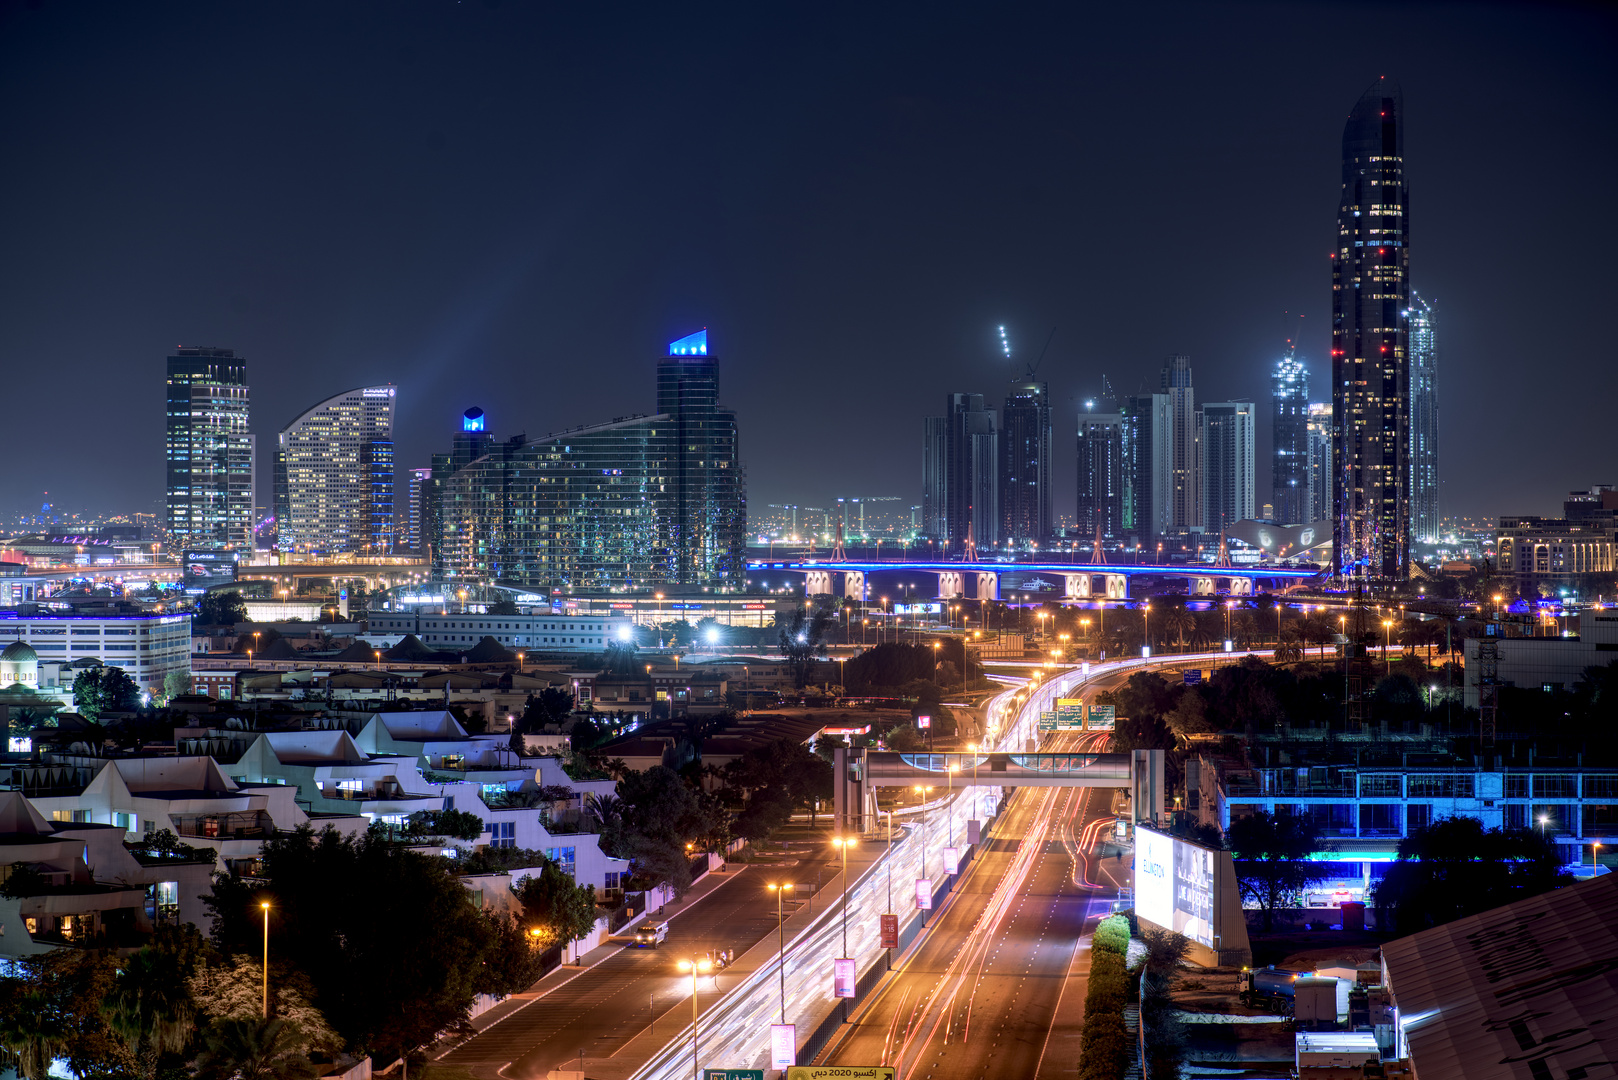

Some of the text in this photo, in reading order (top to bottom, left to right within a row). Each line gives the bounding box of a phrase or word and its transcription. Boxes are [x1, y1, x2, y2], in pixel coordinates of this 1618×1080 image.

[1466, 911, 1569, 984] Carrefour
[811, 1069, 877, 1079] إكسبو 2020 دبي
